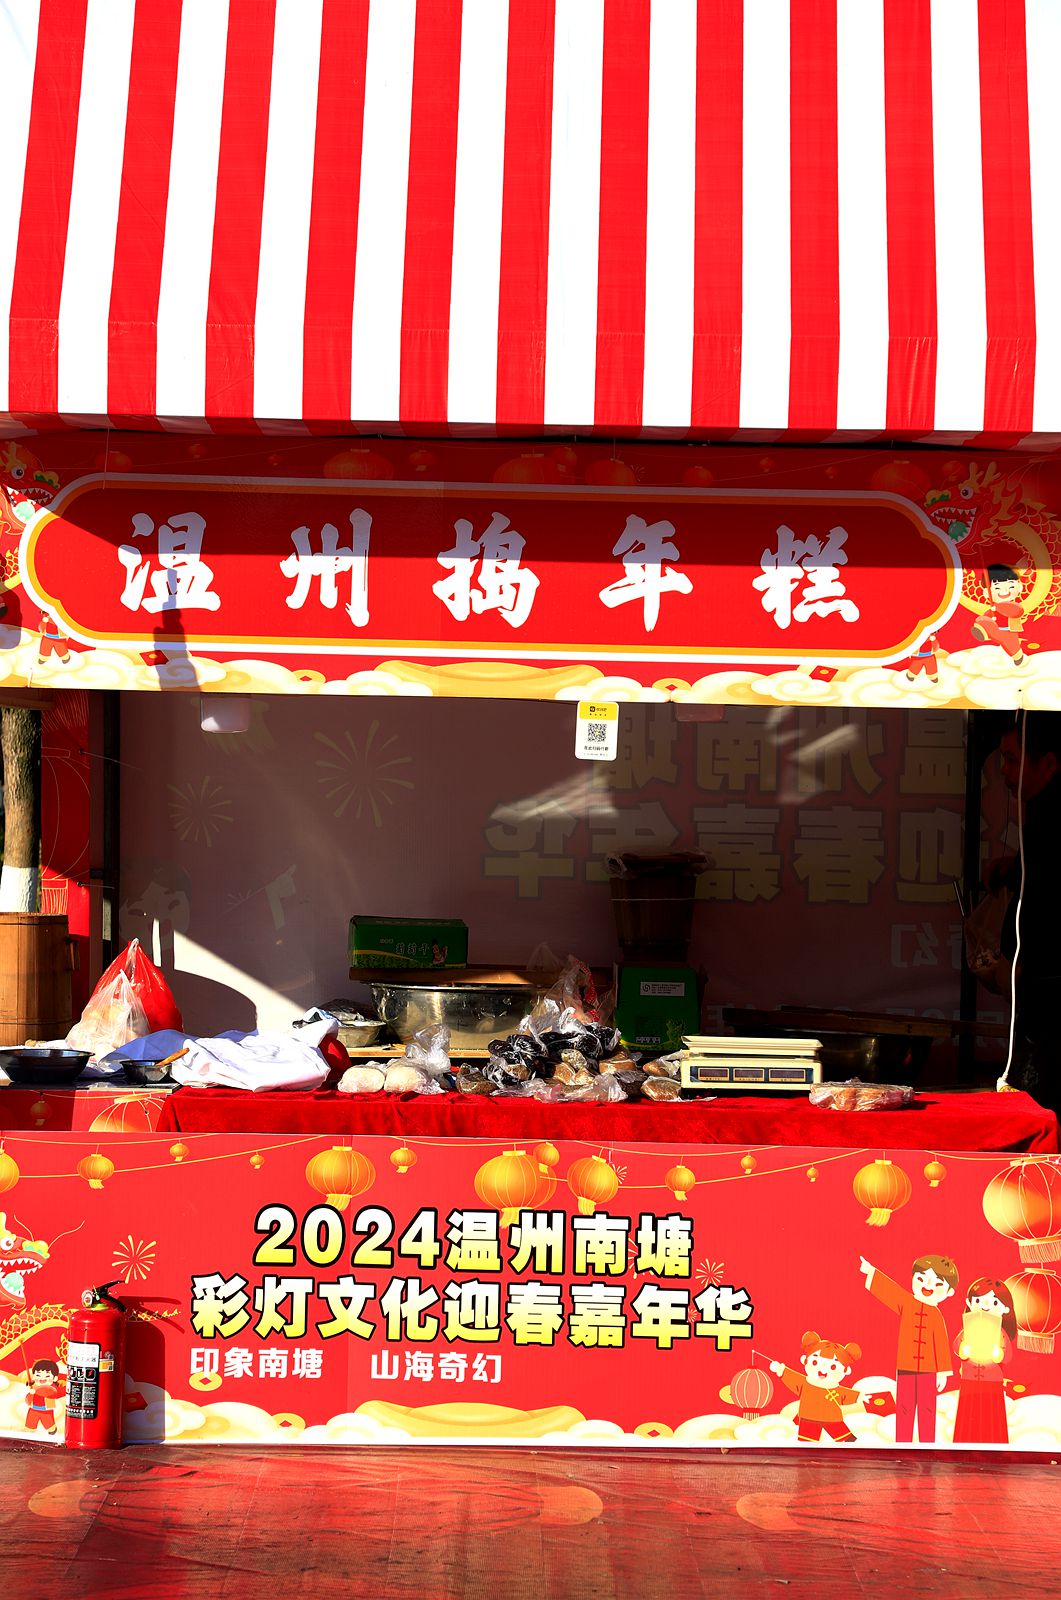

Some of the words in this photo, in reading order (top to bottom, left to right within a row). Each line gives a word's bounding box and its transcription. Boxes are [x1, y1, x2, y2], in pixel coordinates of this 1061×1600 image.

[252, 1203, 696, 1280] 2024温州南塘
[190, 1274, 756, 1352] 彩灯文化迎春嘉年华
[189, 1347, 325, 1381] 印象南塘
[369, 1349, 504, 1385] 山海奇幻
